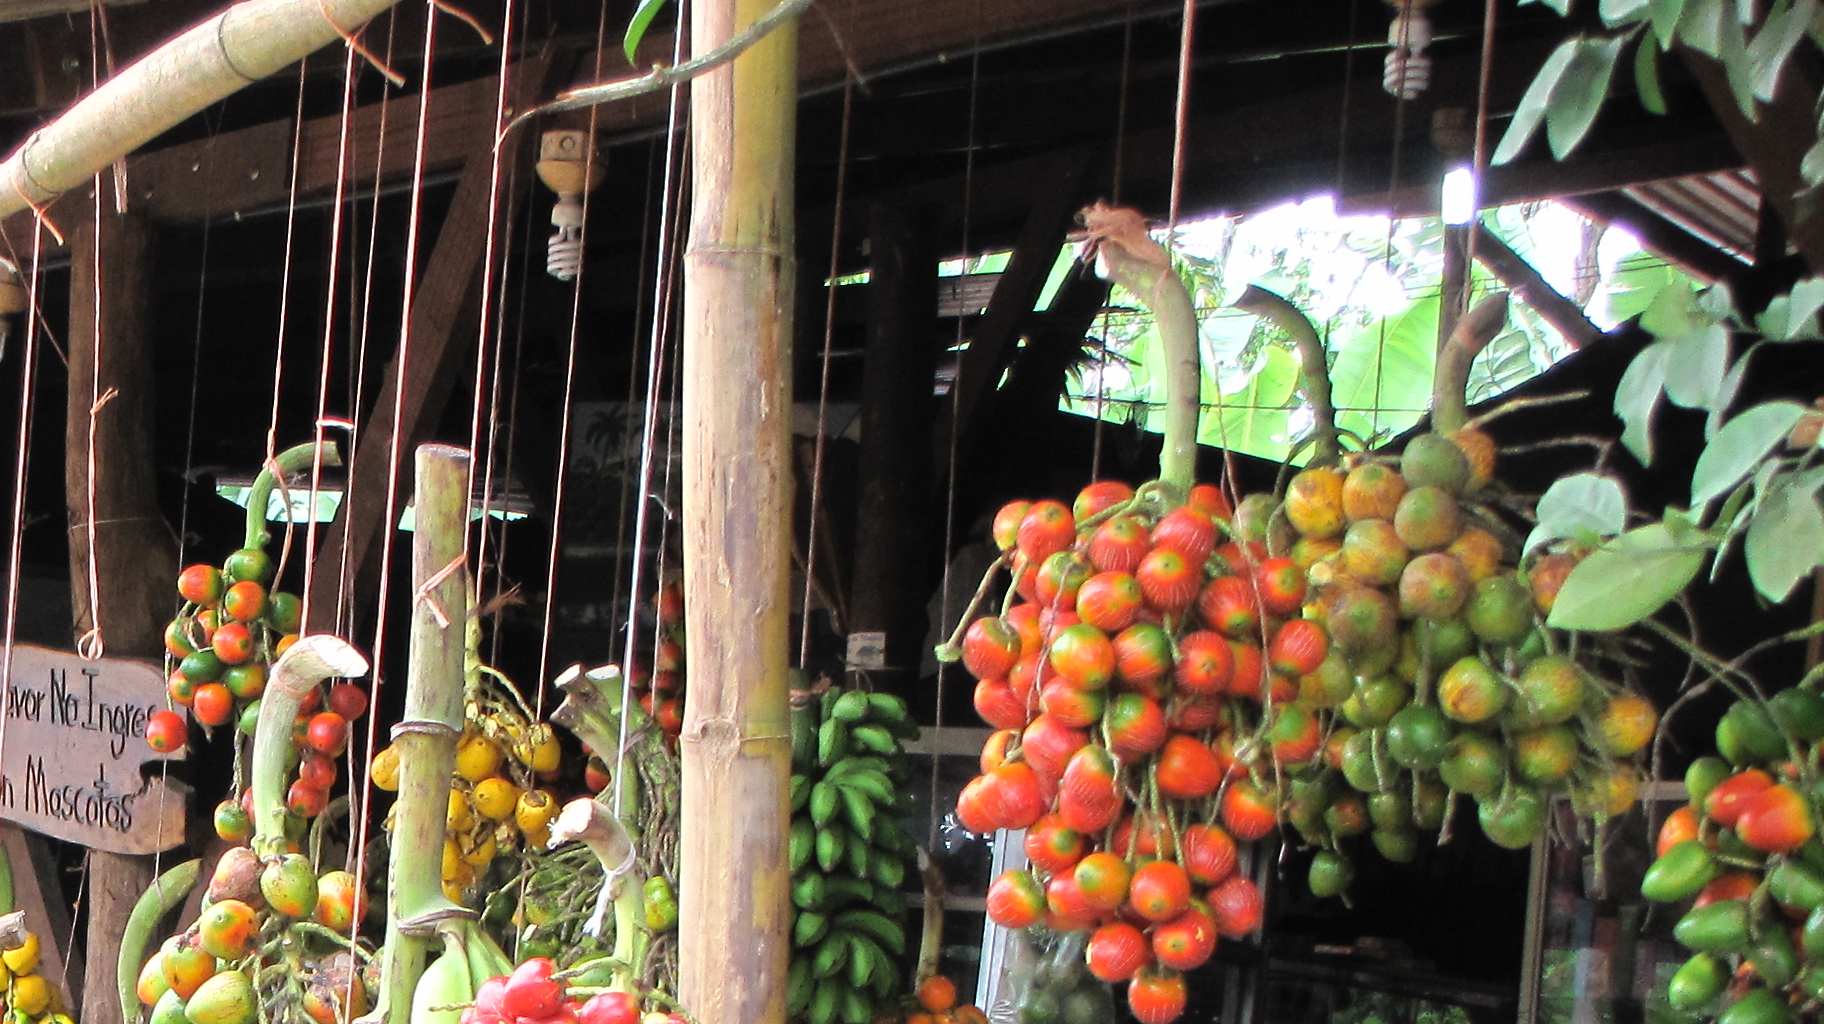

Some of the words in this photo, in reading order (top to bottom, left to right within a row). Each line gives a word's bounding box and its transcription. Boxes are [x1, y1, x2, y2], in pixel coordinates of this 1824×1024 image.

[51, 669, 79, 727] No
[82, 668, 157, 760] Ingres
[26, 754, 135, 832] Mascotas
